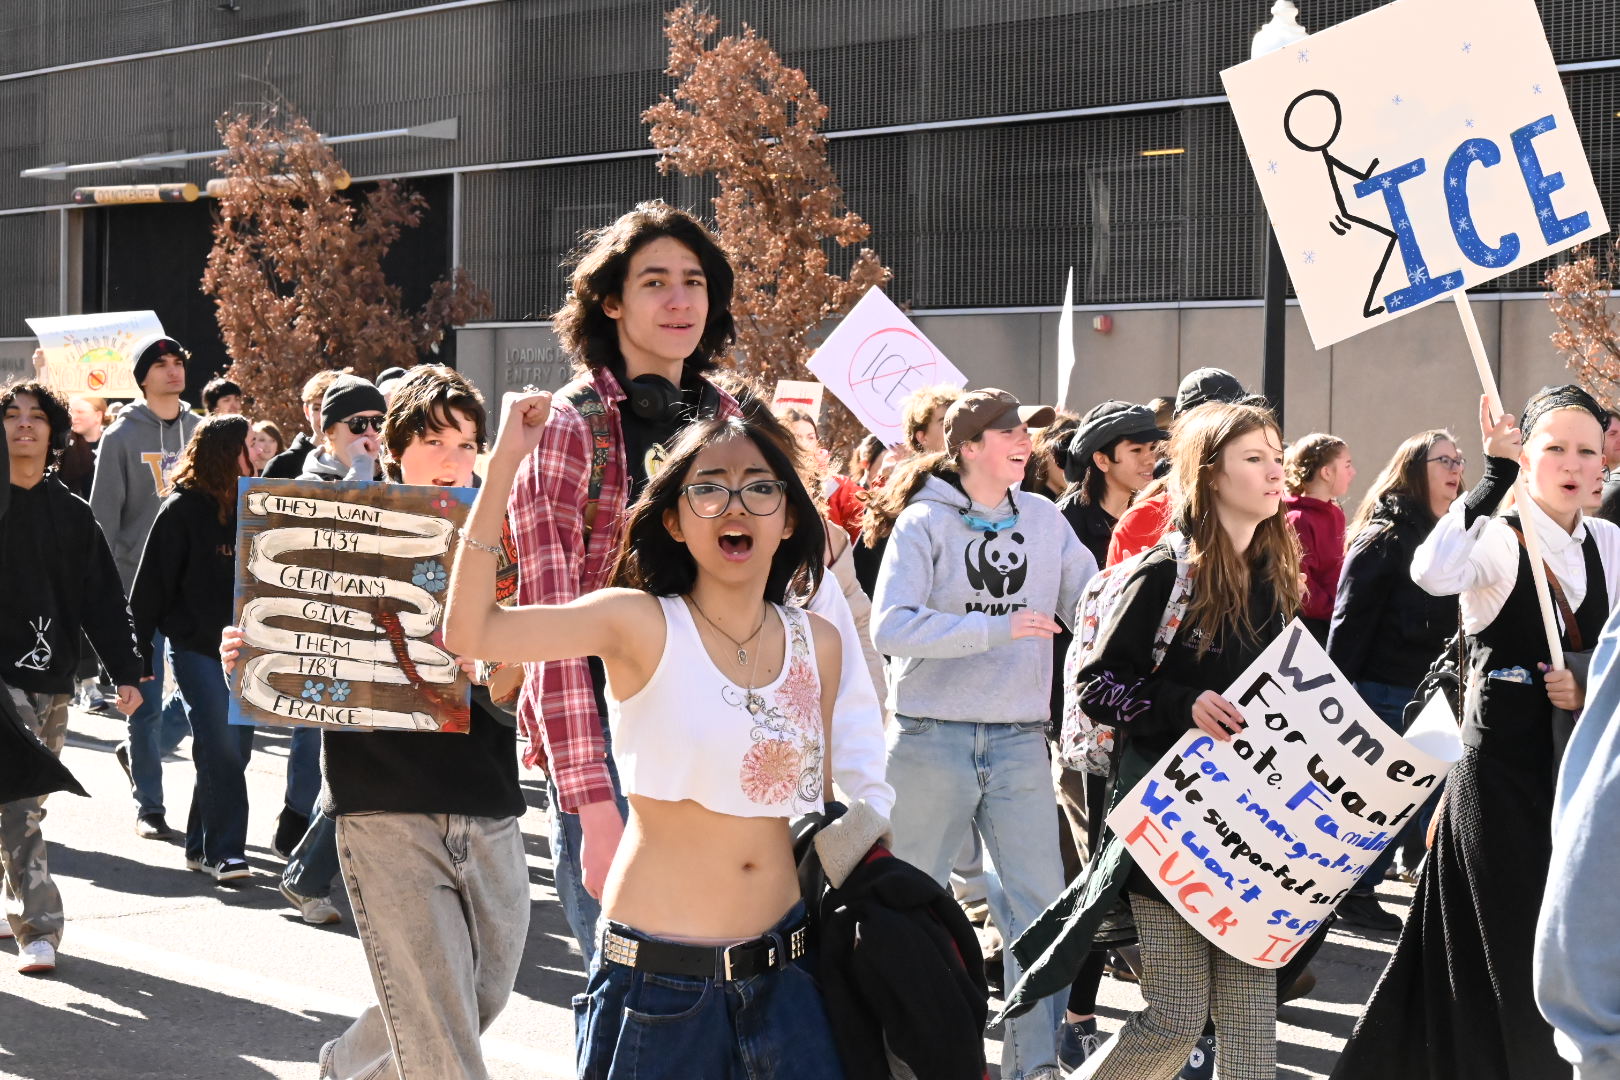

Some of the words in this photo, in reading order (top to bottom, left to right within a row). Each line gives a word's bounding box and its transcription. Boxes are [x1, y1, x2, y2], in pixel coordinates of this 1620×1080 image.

[1353, 114, 1592, 314] ICE
[505, 347, 553, 364] LOADING
[505, 367, 551, 384] ENTRY
[862, 343, 925, 412] ICE
[275, 497, 317, 517] THEY
[337, 505, 383, 523] WANT
[312, 529, 359, 551] 1939
[279, 565, 386, 596] GERMANY
[302, 601, 359, 626] GIVE
[294, 633, 350, 656] THEM
[298, 656, 339, 678] 1789
[272, 694, 361, 725] FRANCE
[1278, 625, 1437, 788] Women
[1238, 671, 1307, 745] For
[1306, 753, 1416, 826] want
[1139, 779, 1182, 830] We
[1163, 753, 1204, 805] We
[1202, 808, 1317, 896] supported
[1124, 815, 1239, 937] FUCK
